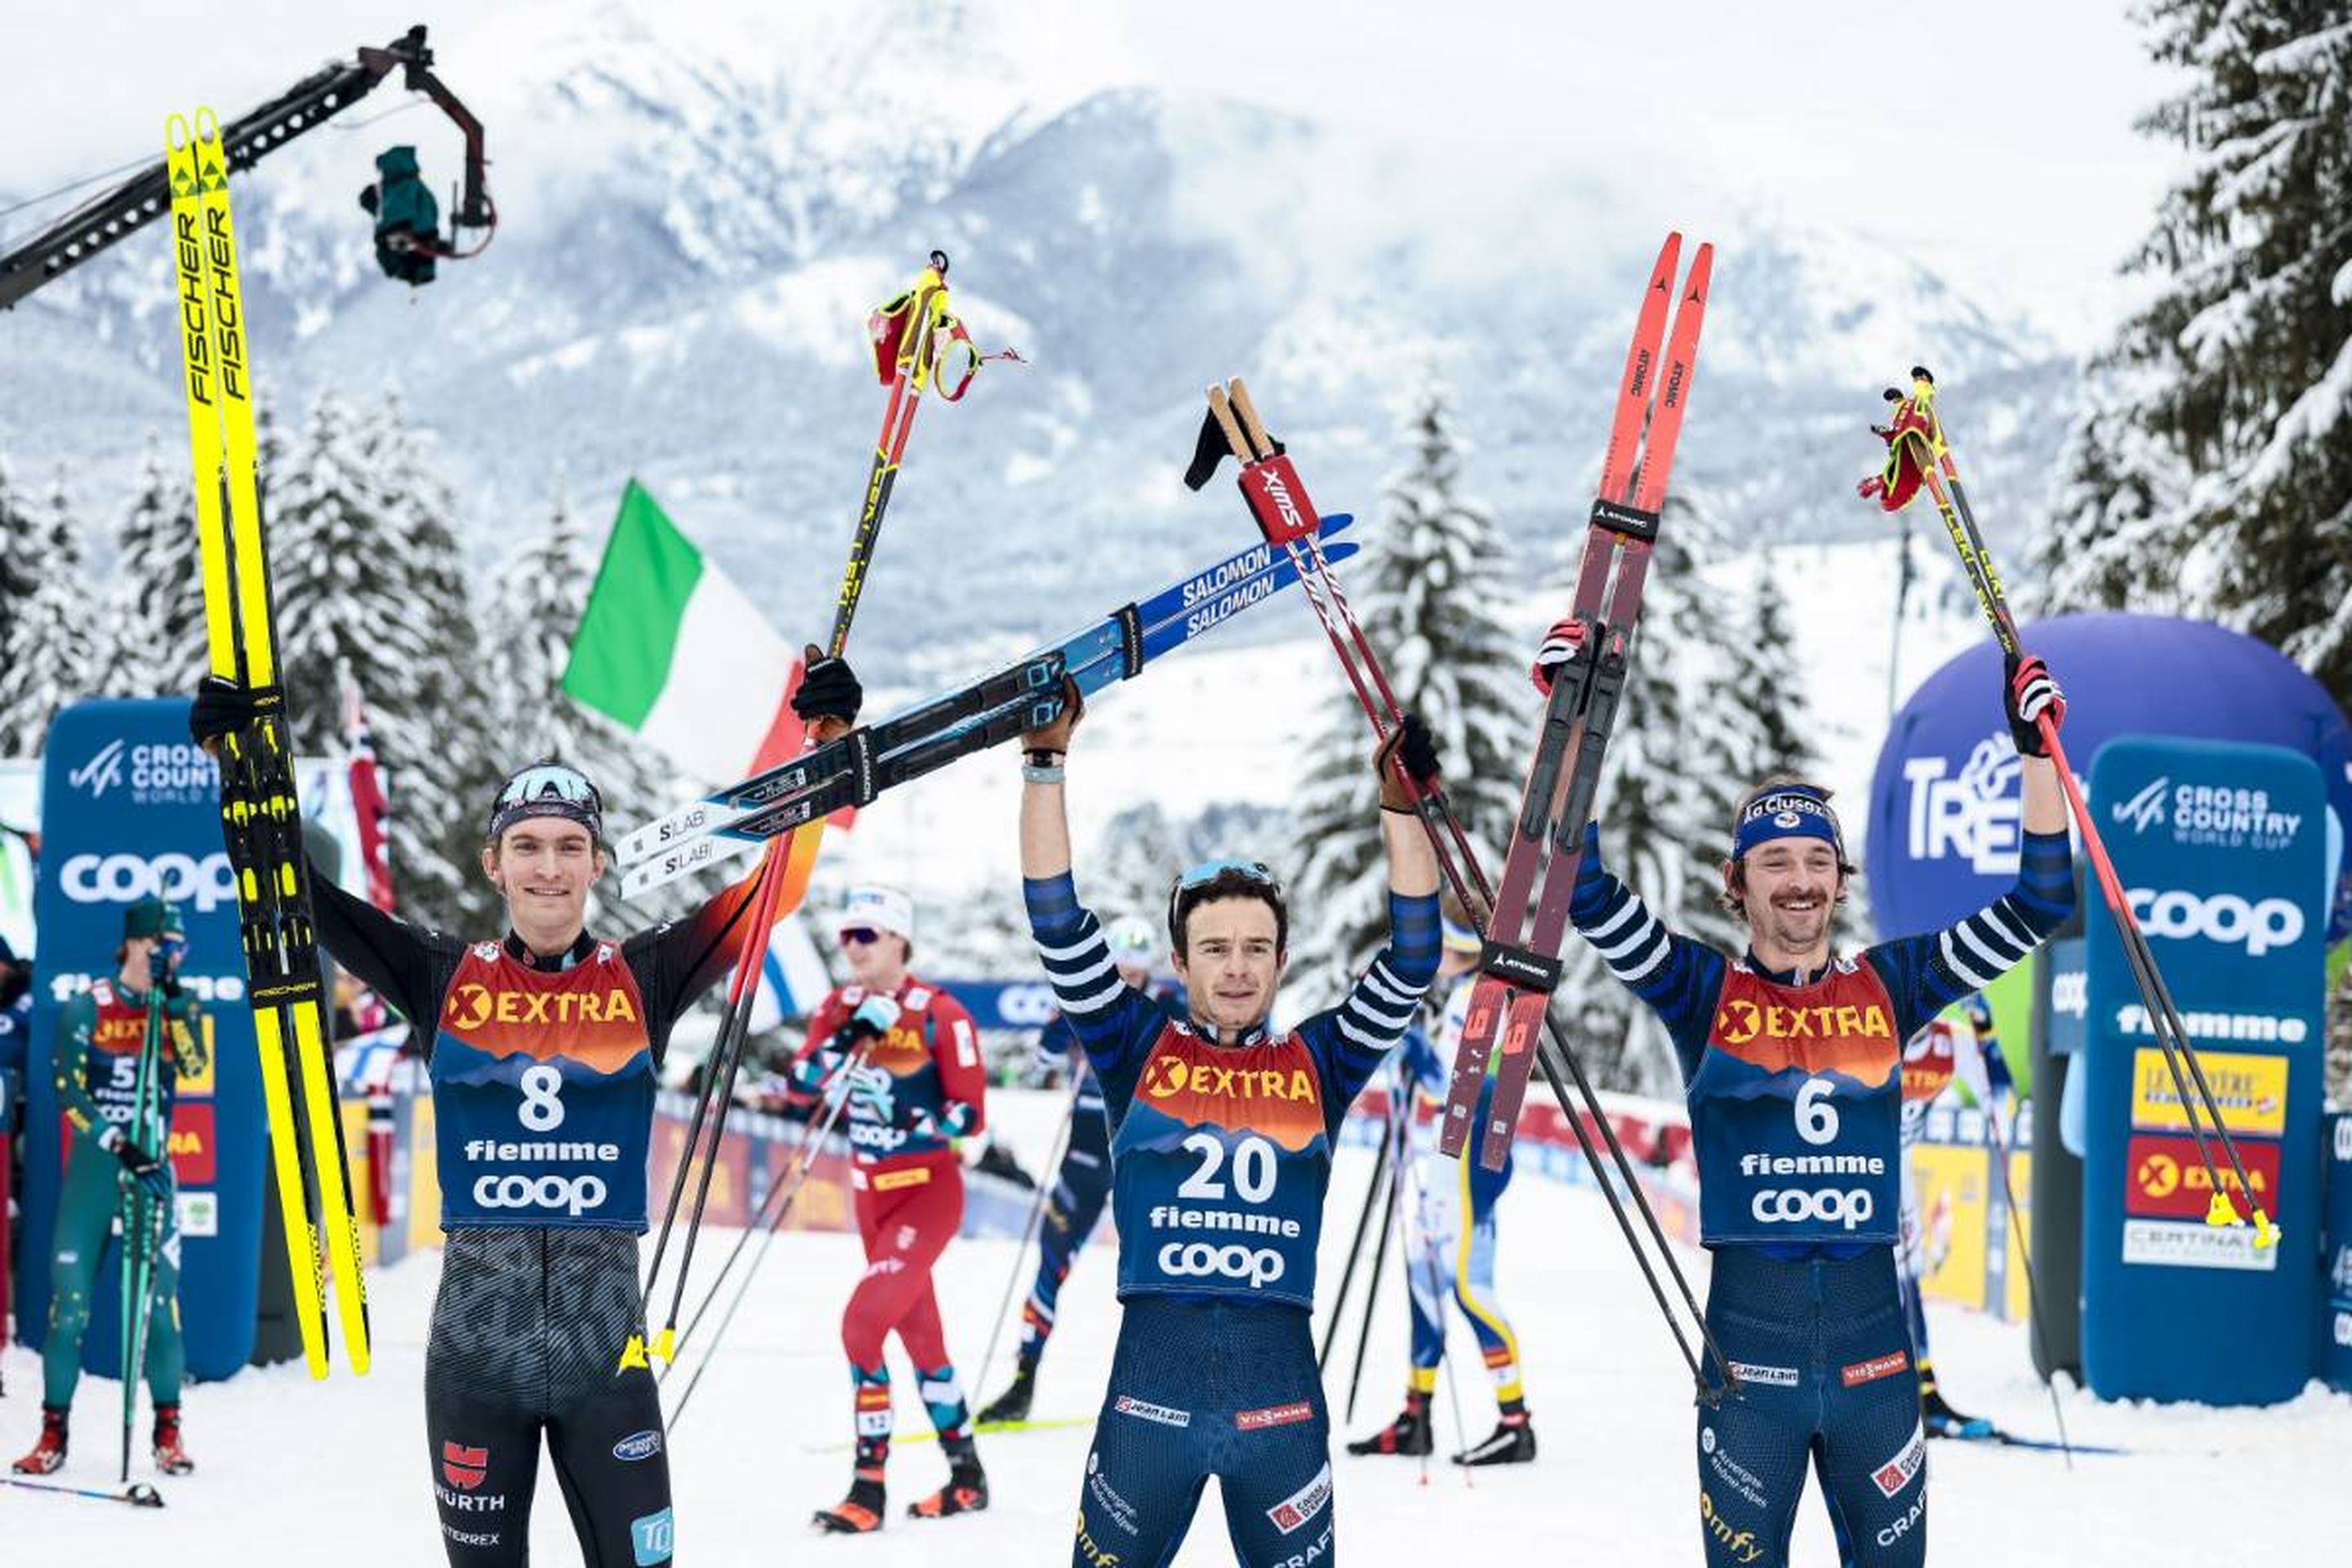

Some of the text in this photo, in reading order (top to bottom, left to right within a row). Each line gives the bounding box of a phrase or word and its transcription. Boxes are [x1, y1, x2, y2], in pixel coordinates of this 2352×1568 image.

[178, 212, 212, 406] FISCHER
[207, 207, 245, 401] FISCHER
[1631, 349, 1650, 397] ATOMIC
[1664, 360, 1684, 408] ATOMIC
[1183, 545, 1271, 608] SALOMON
[1187, 573, 1276, 639] SALOMON
[2175, 785, 2269, 810] CROSS
[2173, 807, 2301, 836] COUNTRY
[2173, 830, 2292, 851] WORLD CUP
[60, 852, 238, 912] coop
[2124, 887, 2305, 956] coop
[497, 988, 636, 1023] EXTRA
[1766, 1004, 1891, 1038] EXTRA
[518, 1065, 565, 1132] 8
[1190, 1065, 1316, 1103] EXTRA
[1793, 1078, 1839, 1145] 6
[464, 1140, 620, 1161] fiemme
[1177, 1132, 1277, 1204] 20
[1740, 1153, 1885, 1175] fiemme
[472, 1174, 607, 1216] coop
[1751, 1188, 1873, 1230] coop
[1149, 1205, 1300, 1238] fiemme
[1157, 1242, 1285, 1289] coop
[1699, 1492, 1764, 1563] omfy
